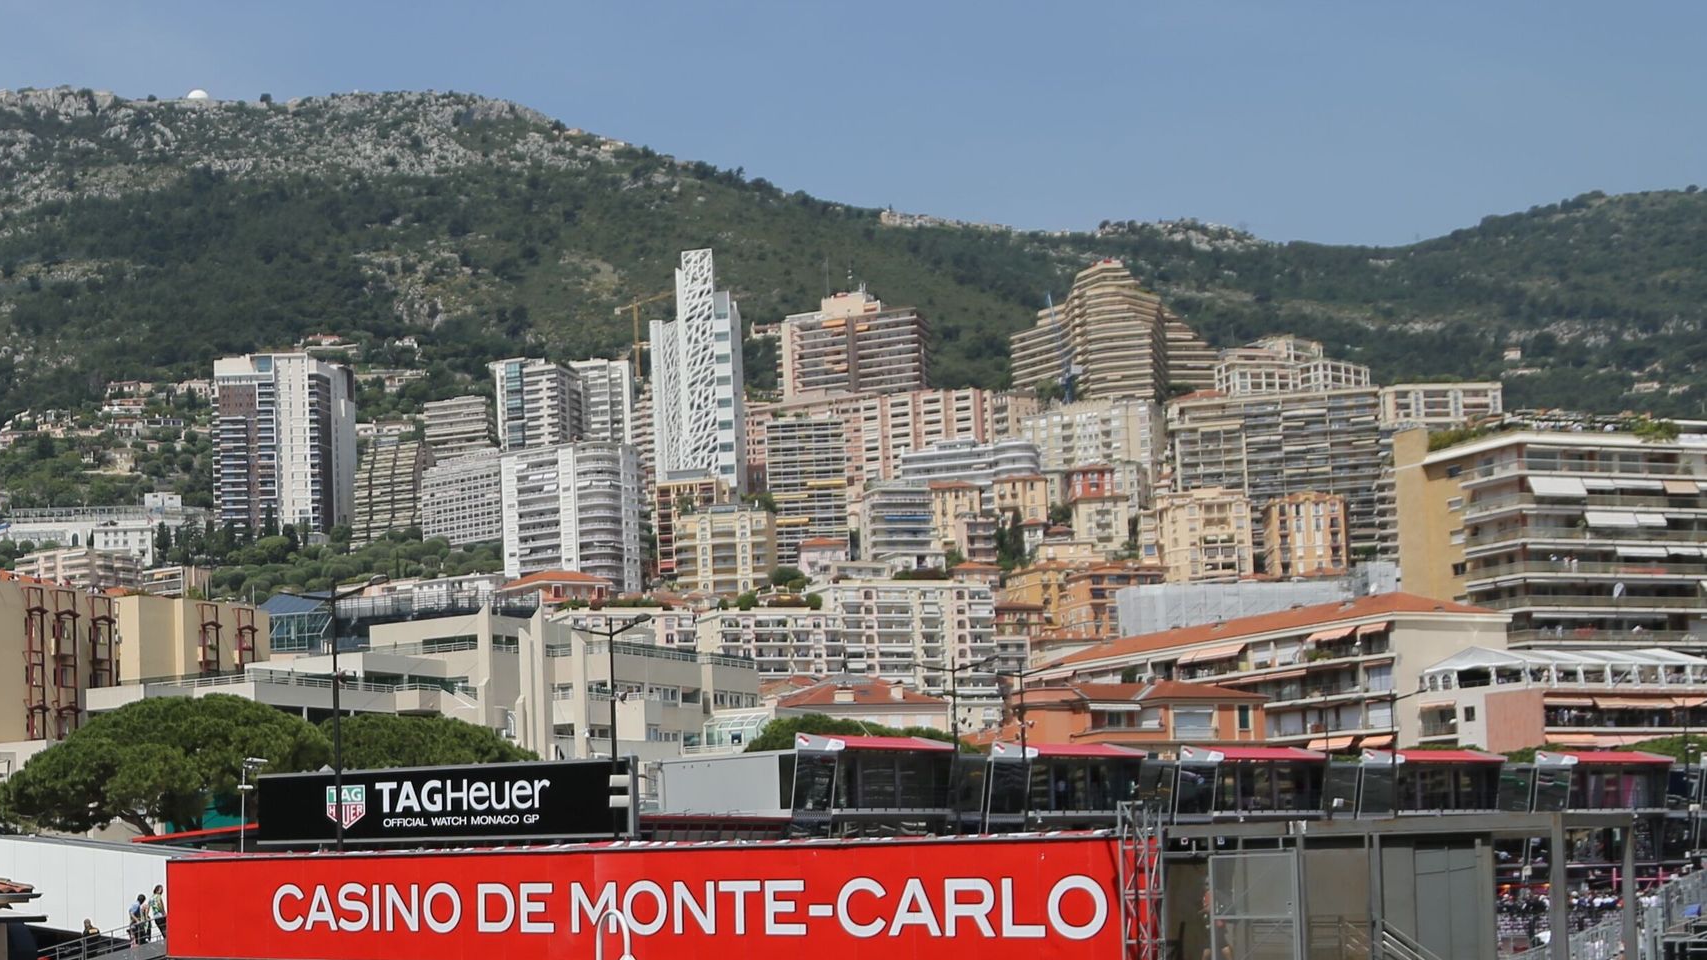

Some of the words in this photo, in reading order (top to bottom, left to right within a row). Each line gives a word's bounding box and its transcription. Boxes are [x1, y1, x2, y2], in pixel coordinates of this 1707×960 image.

[329, 804, 363, 826] HUER
[382, 816, 428, 828] OFFICIAL
[431, 816, 467, 827] WATCH
[470, 814, 520, 826] MONACO
[523, 814, 540, 825] GP
[272, 882, 462, 933] CASINO
[476, 882, 555, 933] DE
[570, 875, 1108, 941] MONTE-CARLO
